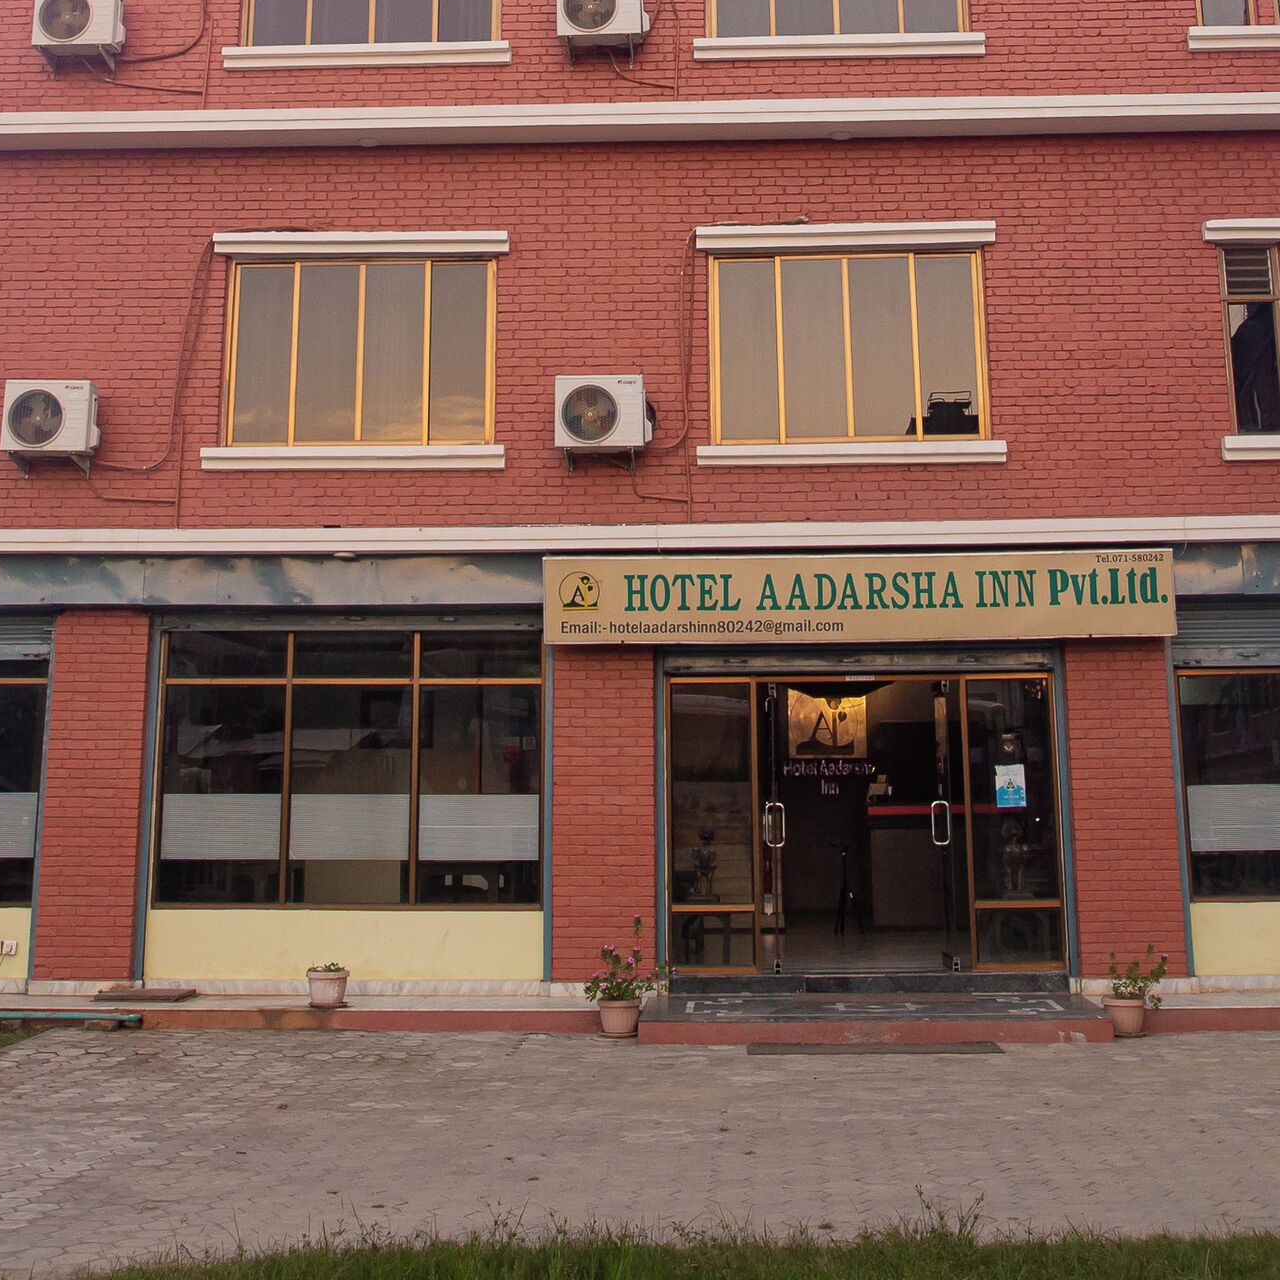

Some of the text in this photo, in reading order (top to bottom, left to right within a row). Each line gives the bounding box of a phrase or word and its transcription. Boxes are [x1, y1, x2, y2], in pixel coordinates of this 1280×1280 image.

[1095, 553, 1164, 563] Tel.071-580242
[623, 566, 1169, 612] HOTEL AADARSHA INN Pvt.Ltd.
[609, 619, 844, 635] hotelaadarshinn80242@gmail.com
[821, 779, 840, 795] Inn
